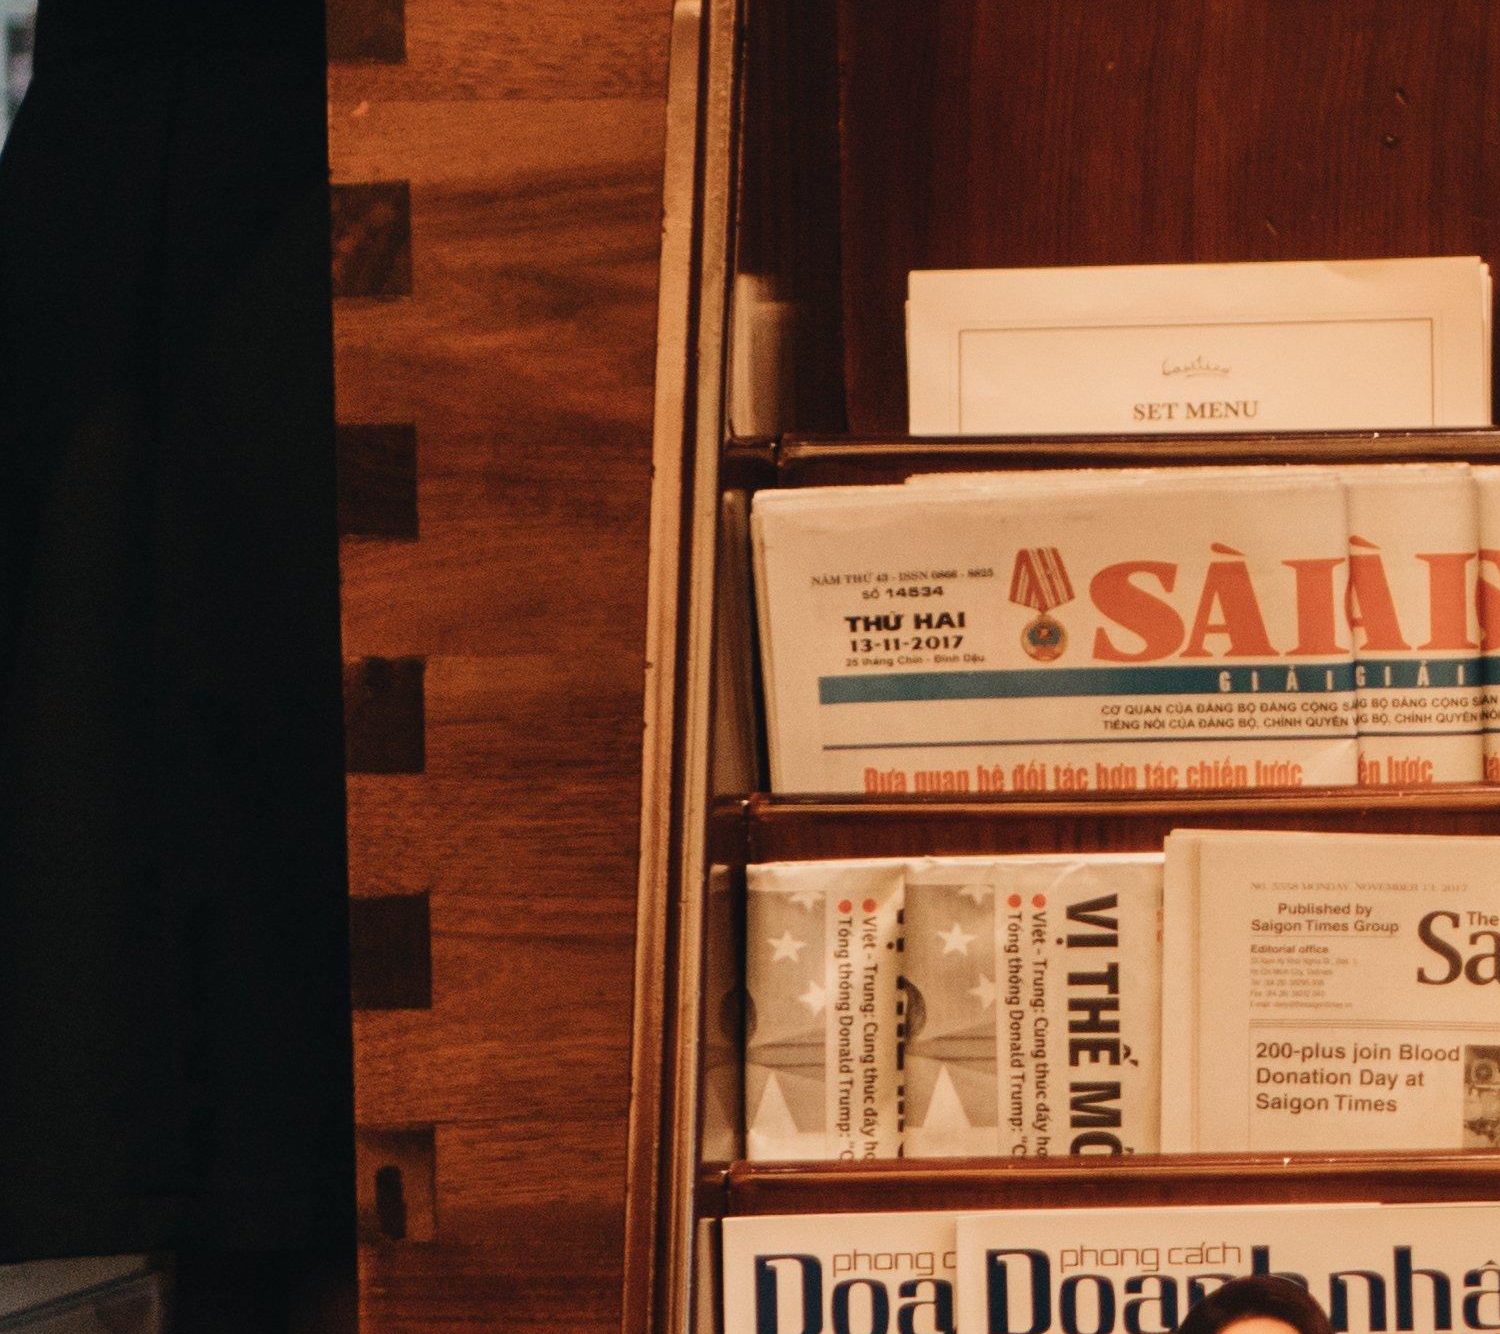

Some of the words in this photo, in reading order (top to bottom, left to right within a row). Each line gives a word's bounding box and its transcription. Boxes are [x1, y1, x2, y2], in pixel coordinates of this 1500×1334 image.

[1133, 402, 1178, 420] SET
[1186, 401, 1258, 418] MENU
[886, 586, 944, 598] 14534
[1092, 543, 1355, 662] SÀI
[844, 611, 903, 632] THỨ
[914, 612, 965, 629] HAI
[851, 635, 963, 652] 13-11-2017
[1125, 704, 1161, 716] QUAN
[1167, 703, 1191, 713] CỦA
[1197, 702, 1233, 713] ĐẢNG
[1238, 703, 1256, 714] BỘ
[1260, 700, 1296, 712] ĐẢNG
[1301, 700, 1337, 714] CỘNG
[1056, 893, 1119, 948] VỊ
[1278, 903, 1350, 915] Published
[1356, 904, 1372, 917] by
[1465, 911, 1500, 927] The
[1004, 913, 1022, 956] Tổng
[1251, 919, 1302, 934] Saigon
[1305, 920, 1349, 932] Times
[1353, 920, 1399, 934] Group
[1250, 945, 1296, 954] Editorial
[1298, 945, 1329, 954] office
[1006, 958, 1024, 1006] thống
[1065, 962, 1140, 1067] THẾ
[838, 1011, 854, 1071] Donald
[1008, 1010, 1025, 1068] Donald
[1256, 1042, 1347, 1064] 200-plus
[1351, 1043, 1394, 1064] join
[1399, 1043, 1461, 1062] Blood
[1256, 1067, 1352, 1086] Donation
[1359, 1069, 1399, 1091] Day
[1405, 1070, 1425, 1087] at
[837, 1075, 856, 1138] Trump:
[1009, 1072, 1027, 1132] Trump:
[1256, 1092, 1330, 1116] Saigon
[1334, 1093, 1398, 1113] Times
[832, 1248, 934, 1278] phong
[1059, 1245, 1160, 1273] phong
[1168, 1242, 1242, 1266] cách
